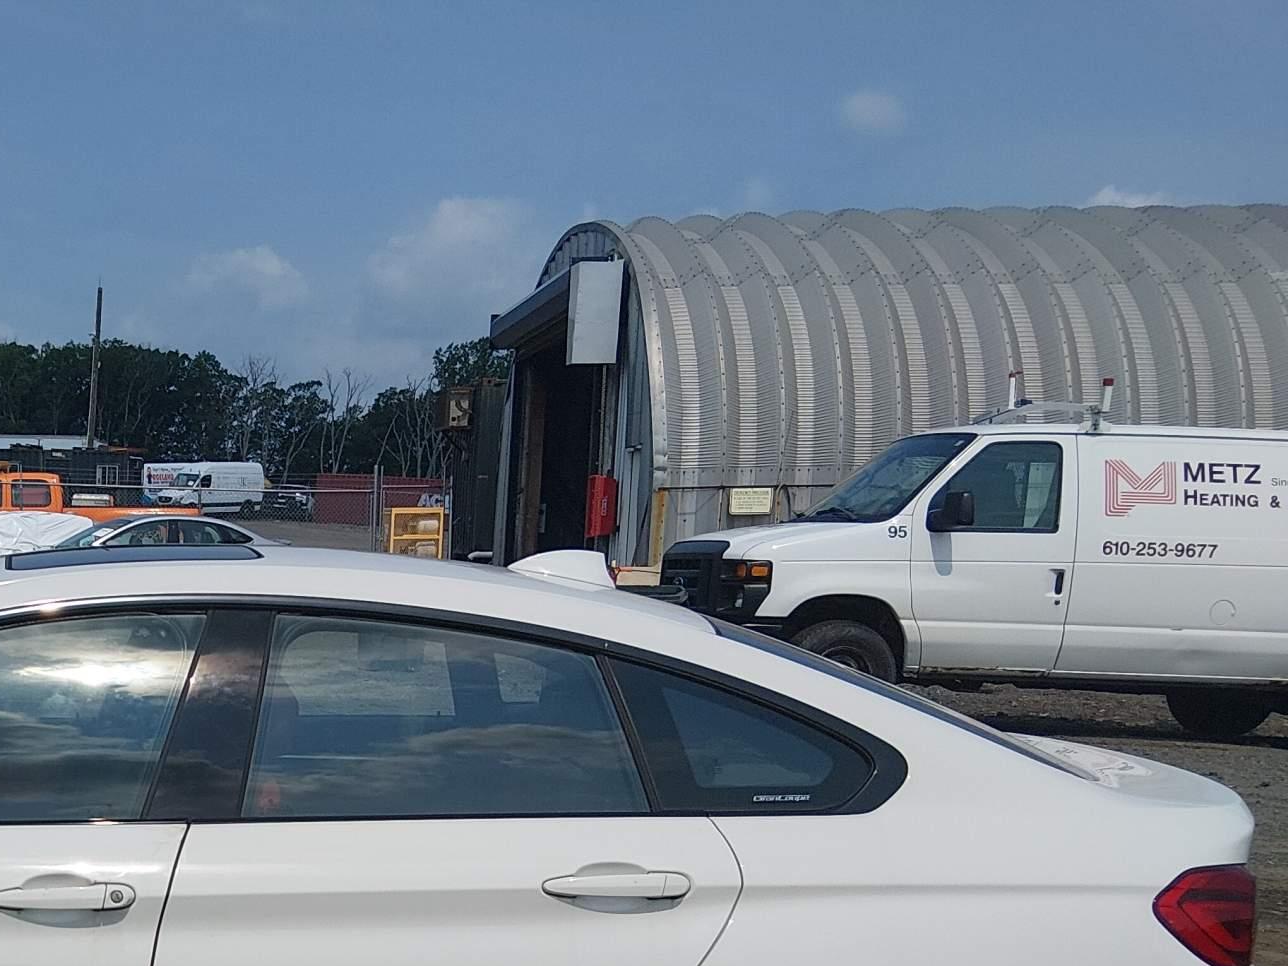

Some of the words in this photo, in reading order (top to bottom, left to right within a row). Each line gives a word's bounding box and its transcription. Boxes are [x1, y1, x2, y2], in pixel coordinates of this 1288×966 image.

[1183, 462, 1262, 484] METZ
[1271, 477, 1288, 487] Sin
[1183, 488, 1259, 508] HEATING
[1269, 495, 1281, 509] &
[887, 525, 908, 539] 95
[1102, 540, 1219, 559] 610-253-9677
